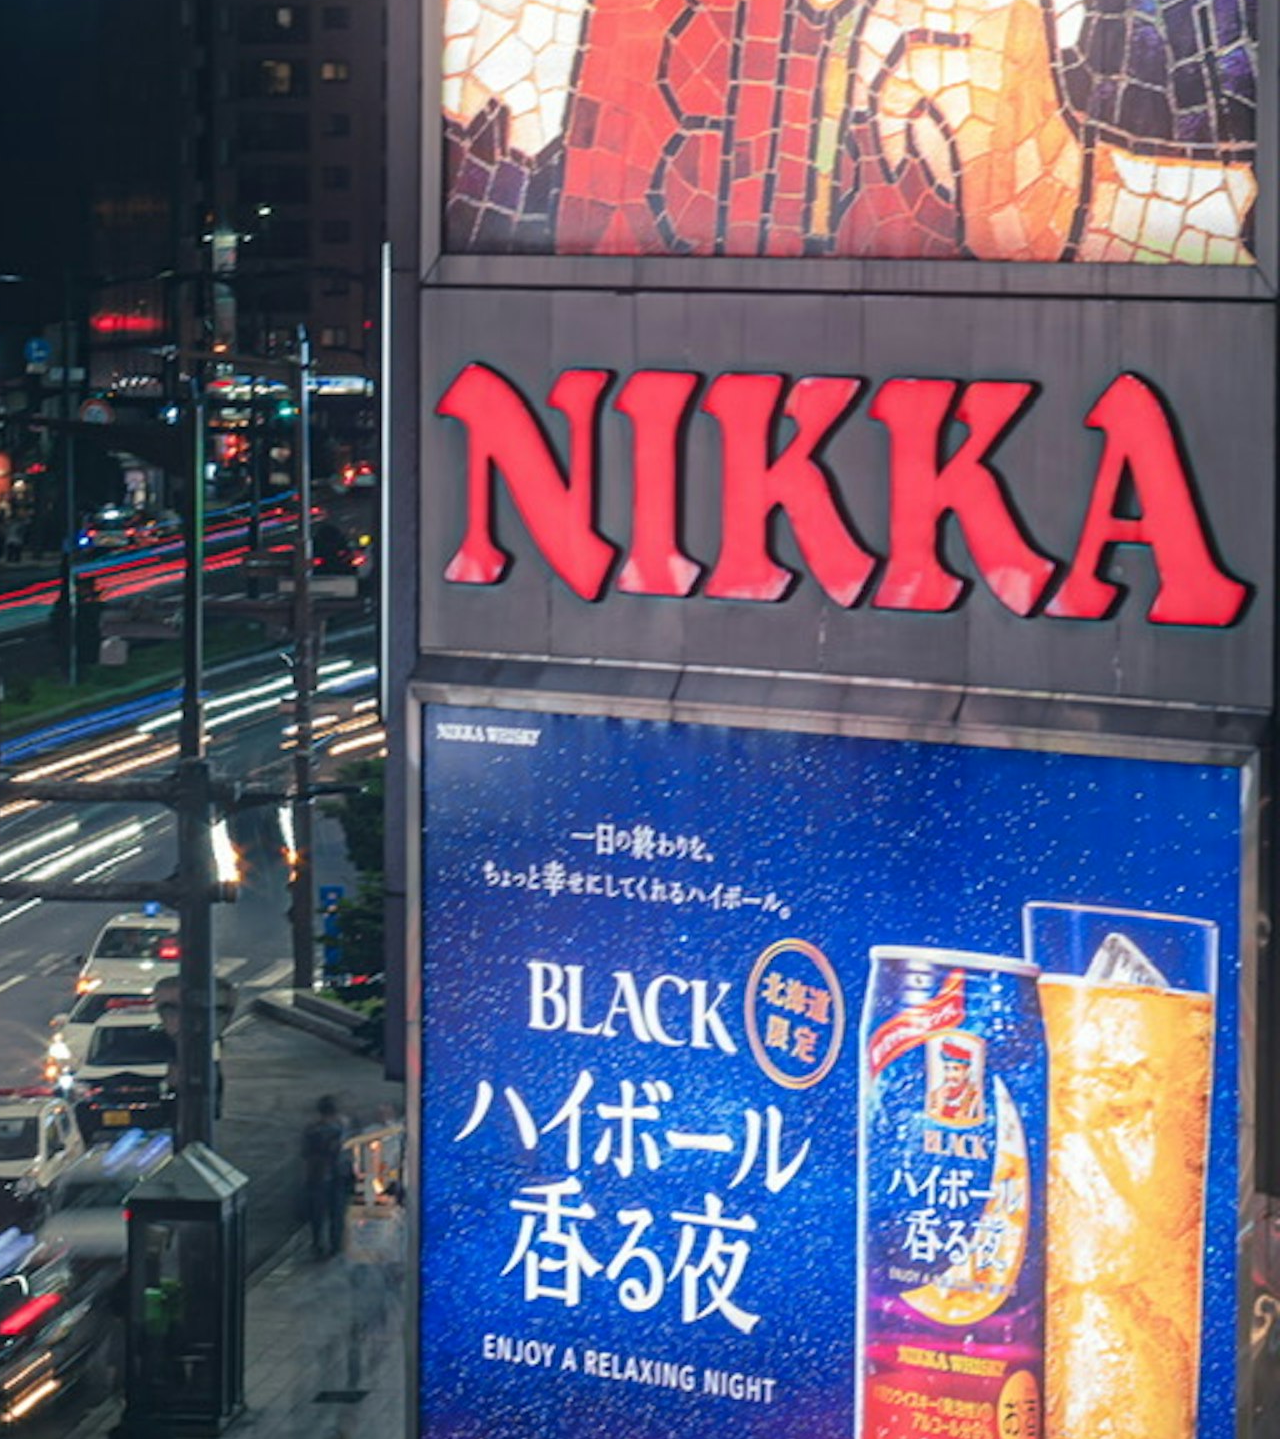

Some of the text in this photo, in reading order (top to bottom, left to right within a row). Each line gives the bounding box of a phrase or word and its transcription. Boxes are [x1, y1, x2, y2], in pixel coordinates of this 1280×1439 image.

[434, 361, 1250, 629] NIKKA
[570, 822, 715, 864] 一日の終わりを、
[482, 859, 792, 921] ちょっと幸せにしてくれるハイボール。
[527, 959, 738, 1055] BLACK
[761, 971, 834, 1025] 北海道
[765, 1016, 817, 1065] 限定
[453, 1069, 812, 1195] ハイボール
[500, 1175, 763, 1337] 香る夜
[482, 1334, 777, 1404] ENJOY A RELAXING NIGHT
